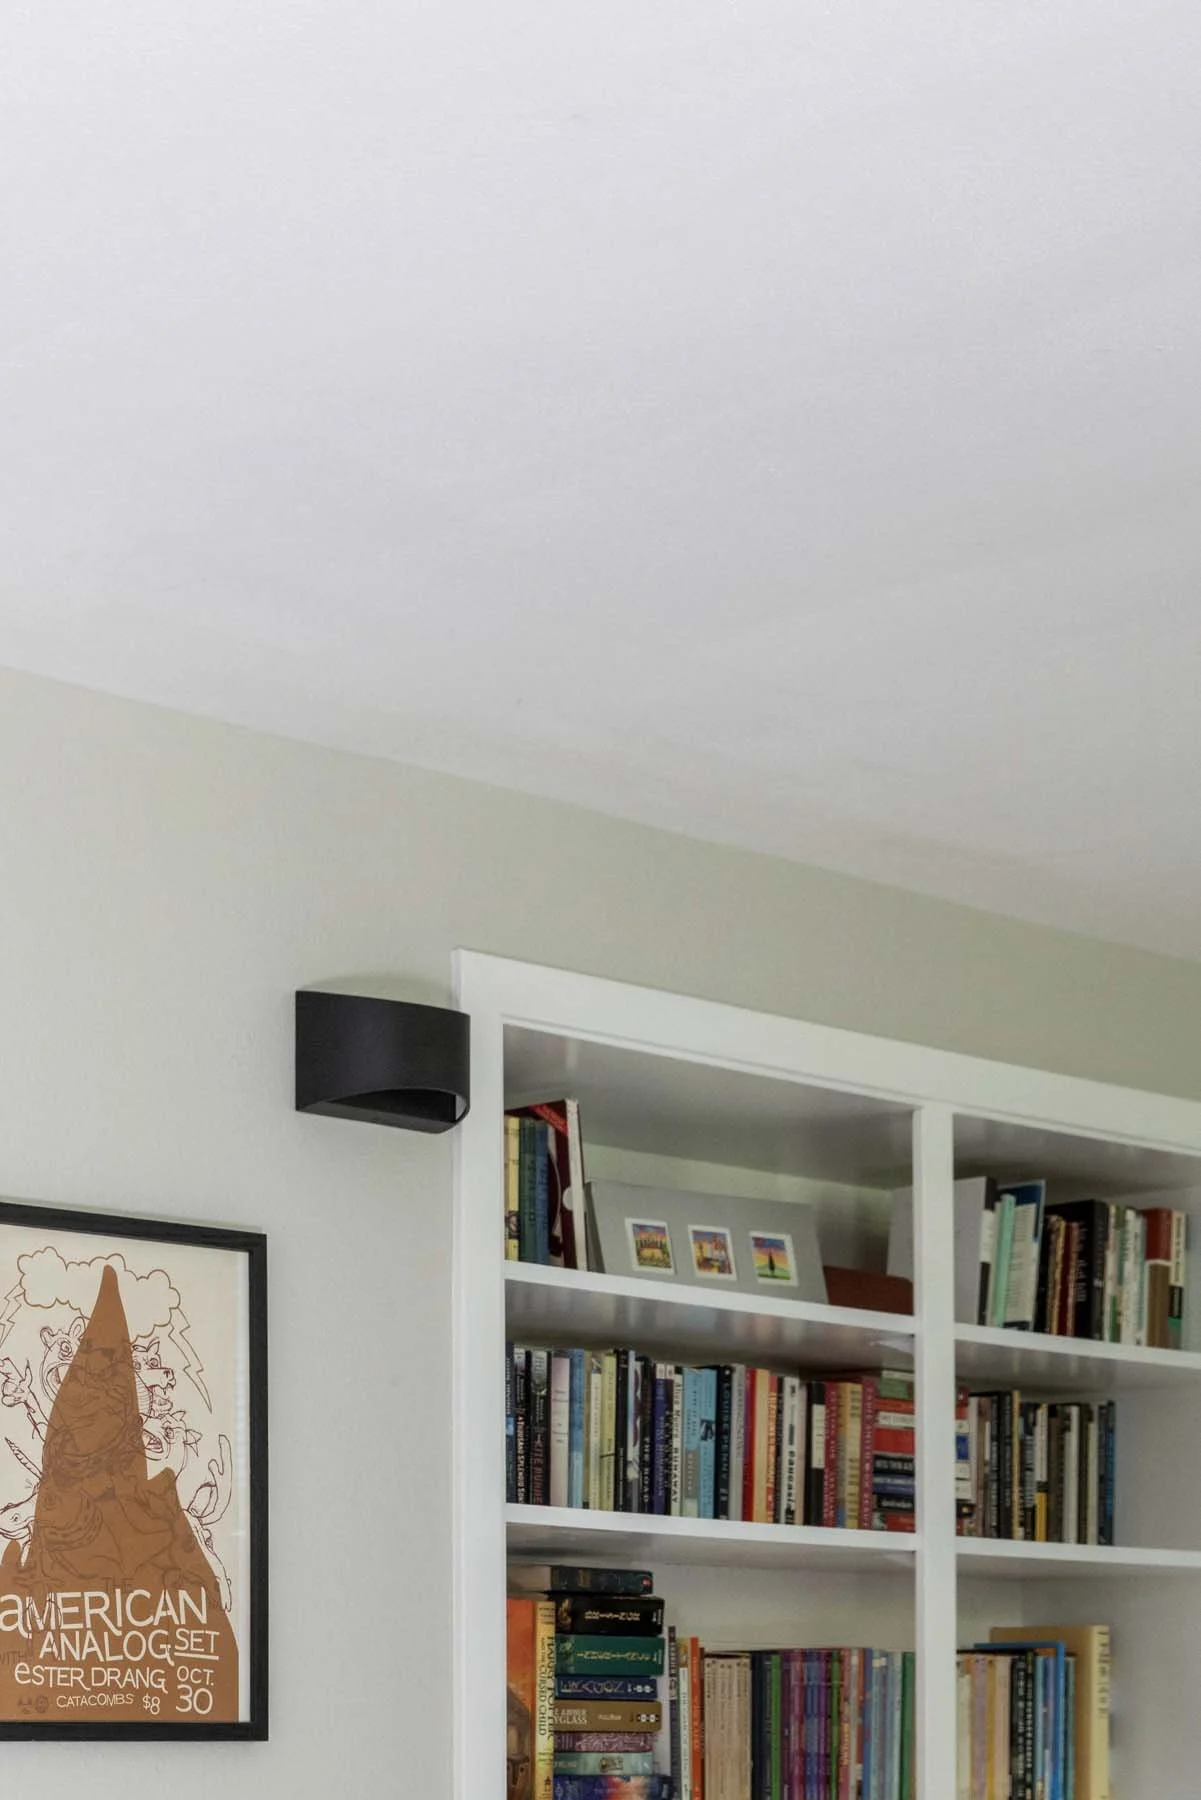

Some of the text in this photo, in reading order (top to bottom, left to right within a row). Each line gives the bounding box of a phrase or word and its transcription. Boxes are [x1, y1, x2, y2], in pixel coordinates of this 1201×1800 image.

[721, 1382, 730, 1480] LOUISE PENNY
[533, 1467, 543, 1505] RUNNE
[672, 1447, 680, 1503] RUNAWAY
[39, 1628, 220, 1666] ANALOG SET
[91, 1665, 168, 1694] DRANG
[176, 1665, 215, 1687] OCT.
[538, 1664, 548, 1702] CURSED
[56, 1692, 161, 1715] CATACOMBS $8
[175, 1684, 214, 1715] 30
[538, 1704, 548, 1736] CHILD
